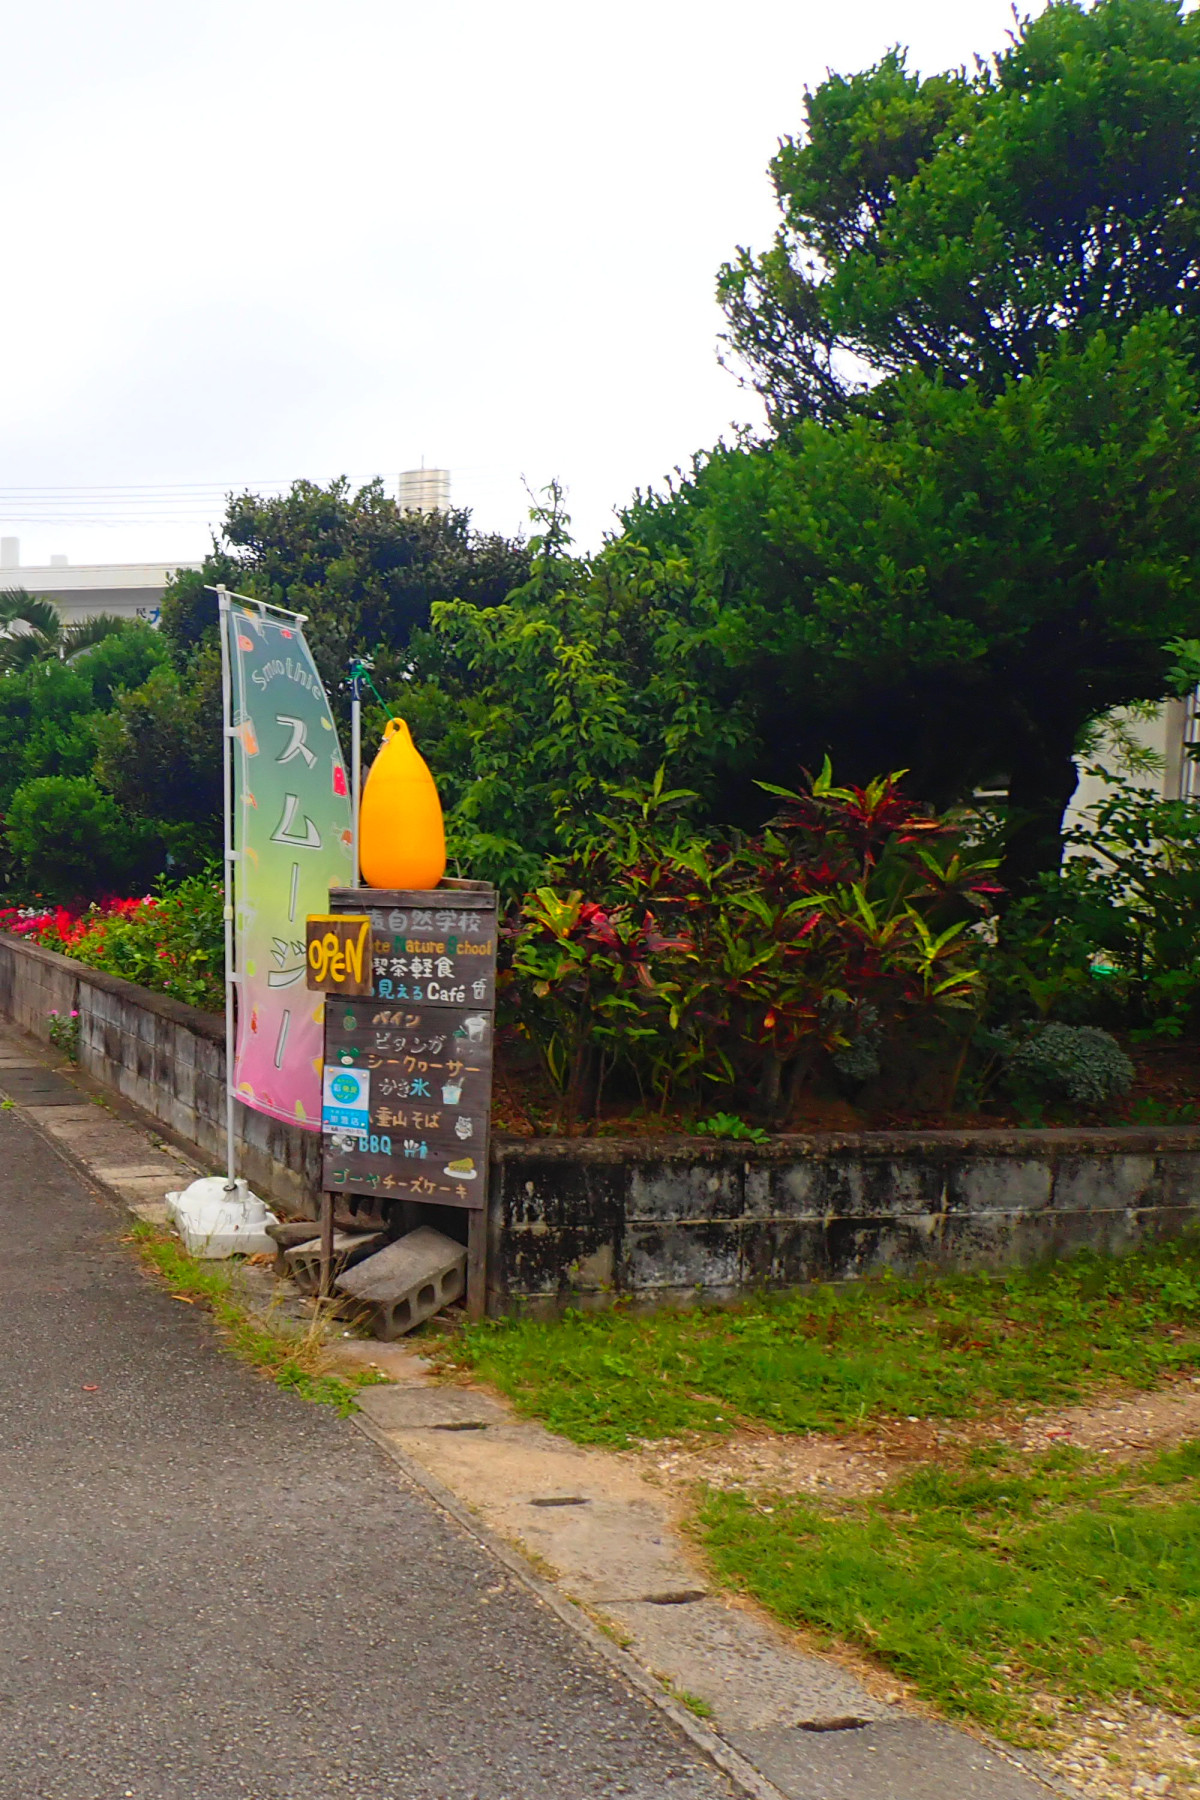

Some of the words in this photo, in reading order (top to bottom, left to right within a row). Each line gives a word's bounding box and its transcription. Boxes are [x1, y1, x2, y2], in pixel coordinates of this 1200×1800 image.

[267, 713, 322, 1069] スムージー
[308, 921, 371, 984] OPEN
[395, 936, 446, 954] Nature
[448, 936, 492, 956] School
[427, 981, 466, 1003] Café
[372, 1010, 422, 1027] パイン
[378, 1077, 432, 1099] かき氷
[358, 1134, 392, 1156] BBQ
